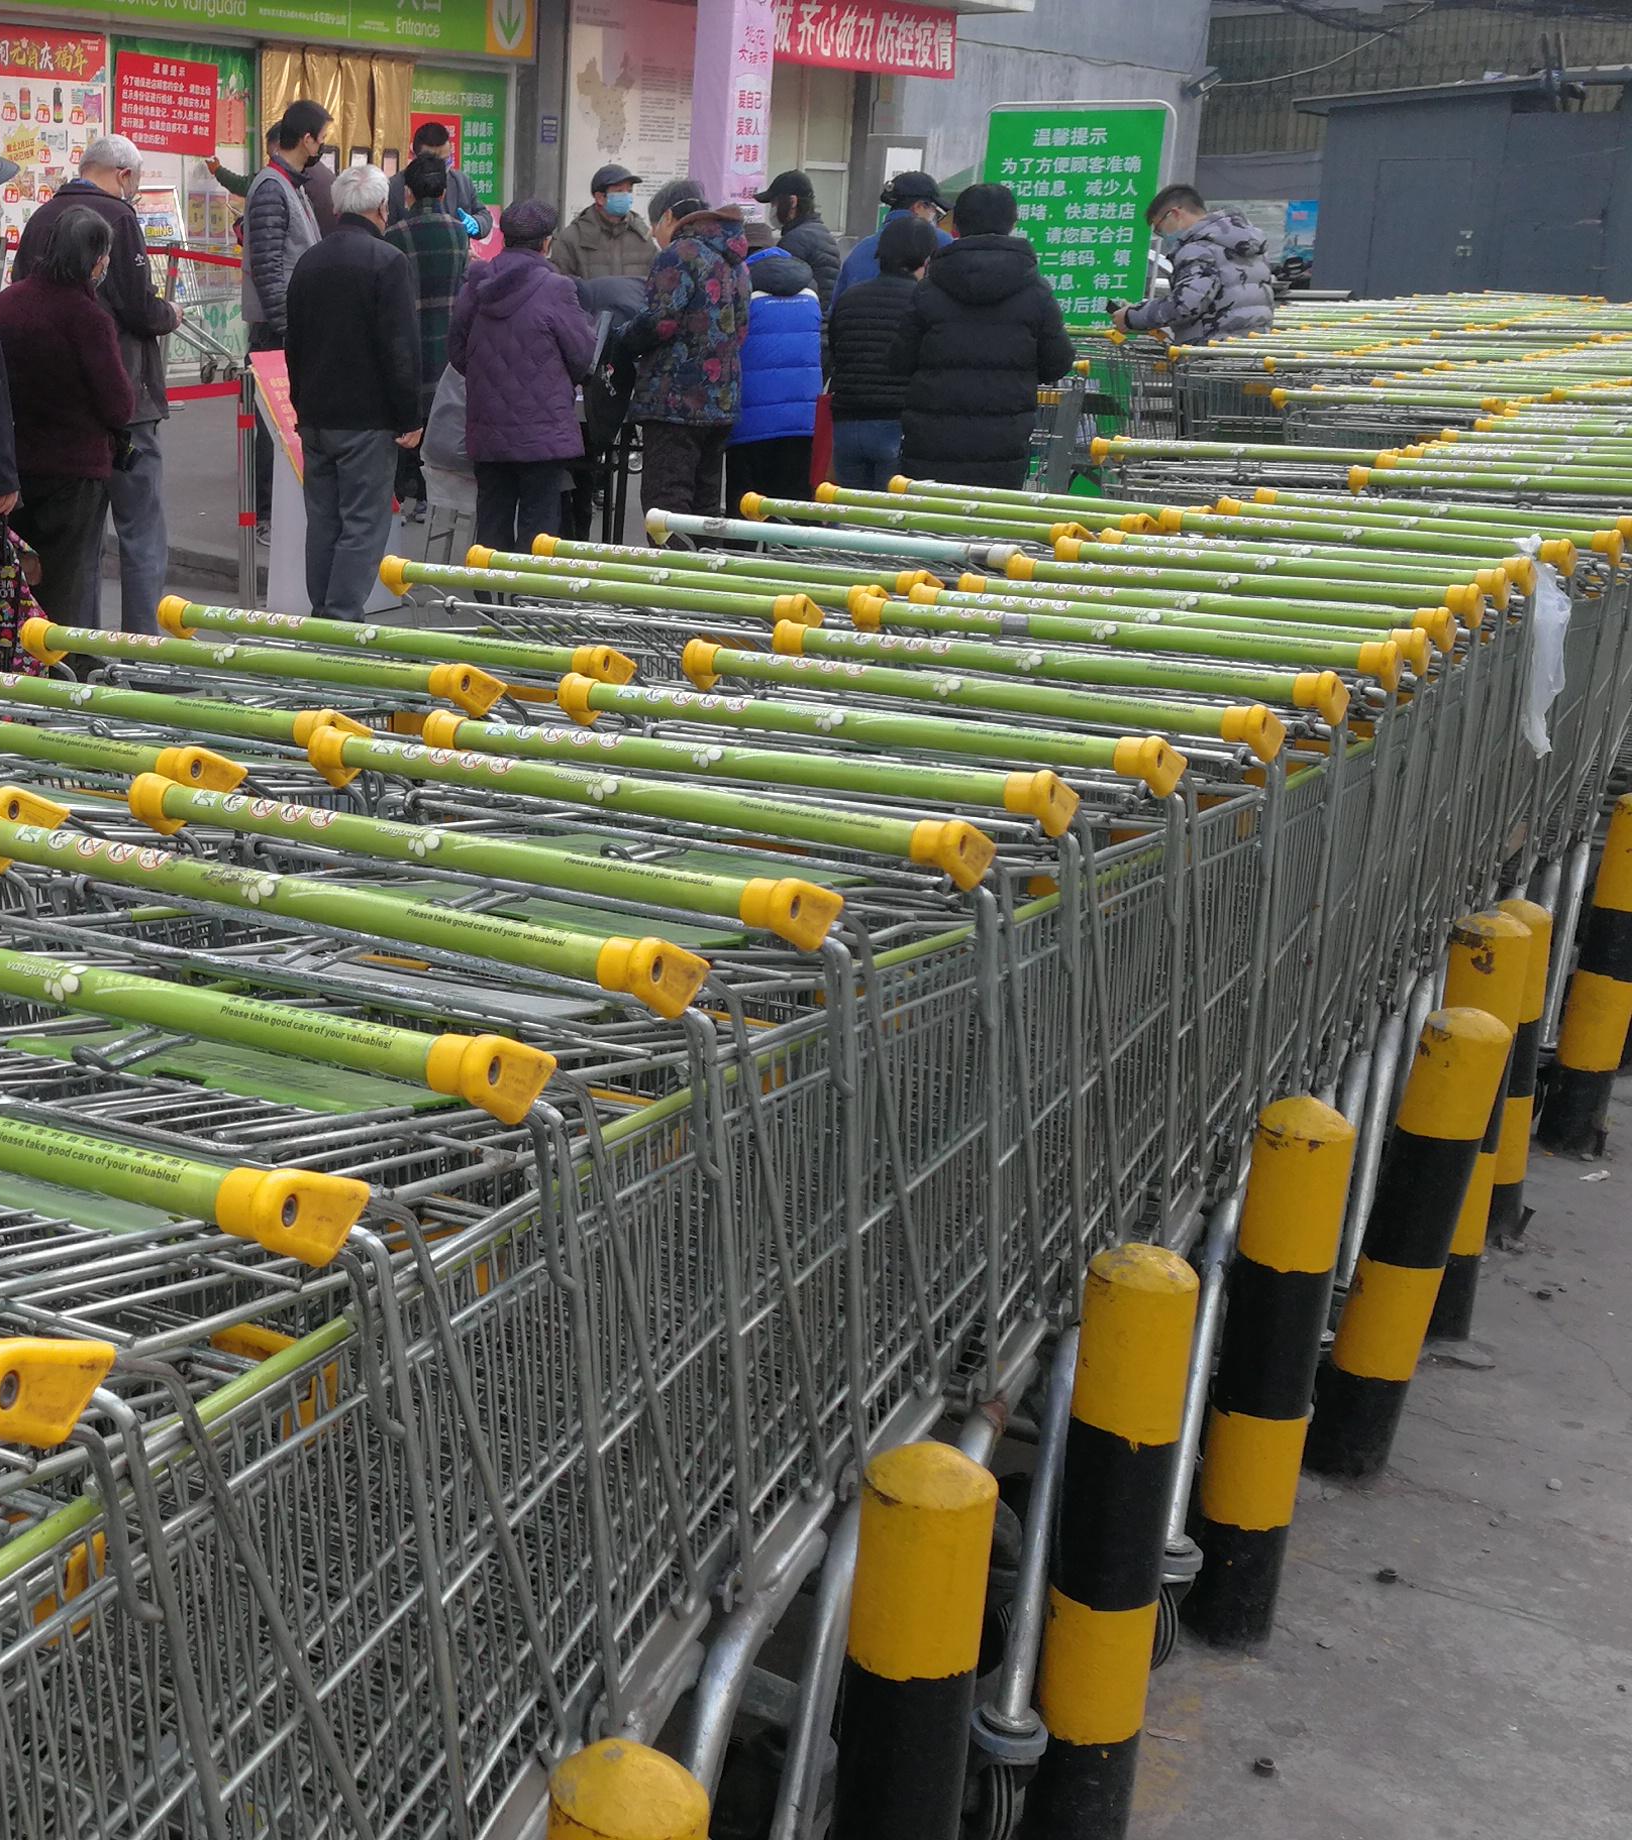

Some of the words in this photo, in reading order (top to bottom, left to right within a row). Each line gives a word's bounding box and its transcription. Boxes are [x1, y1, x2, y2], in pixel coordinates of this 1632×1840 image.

[396, 16, 441, 38] Entrance
[797, 3, 875, 61] 齐心协力
[876, 13, 953, 71] 防控疫情
[1032, 127, 1108, 147] 温馨提示
[1000, 156, 1142, 175] 为了方便顾客准确
[1017, 203, 1136, 221] 拥堵，快速进店
[564, 857, 589, 867] Please
[590, 860, 607, 870] take
[607, 864, 626, 872] good
[626, 867, 645, 876] care
[406, 908, 433, 921] Please
[433, 914, 452, 925] take
[452, 919, 474, 930] good
[474, 923, 493, 934] care
[503, 928, 523, 938] your
[522, 931, 567, 947] valuables!
[6, 962, 63, 979] vanguard
[220, 1005, 249, 1020] Please
[249, 1011, 269, 1024] take
[270, 1016, 293, 1028] good
[293, 1022, 313, 1033] care
[314, 1025, 326, 1034] of
[324, 1029, 346, 1039] your
[346, 1033, 393, 1049] valuables!
[24, 1138, 47, 1152] take
[47, 1144, 72, 1158] good
[72, 1151, 94, 1164] care
[95, 1156, 108, 1165] of
[106, 1159, 130, 1172] your
[130, 1164, 182, 1184] valuables!
